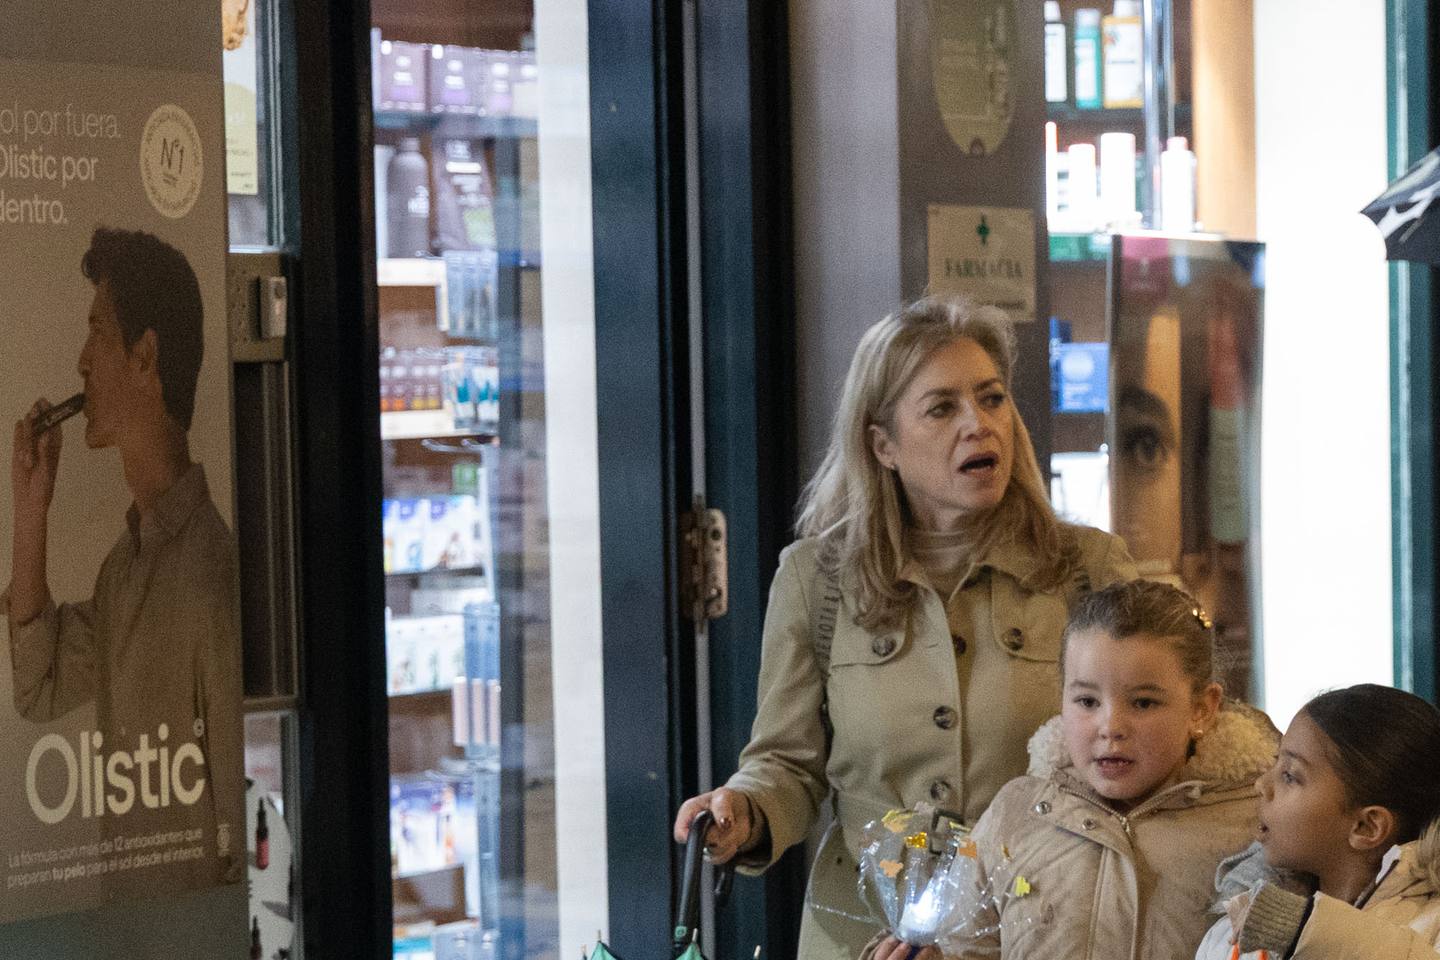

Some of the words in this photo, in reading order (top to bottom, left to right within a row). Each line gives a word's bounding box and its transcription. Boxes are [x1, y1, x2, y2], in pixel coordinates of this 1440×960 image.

[24, 109, 61, 142] por
[64, 103, 122, 139] fuera.
[61, 155, 99, 189] por
[26, 723, 205, 824] Olistic
